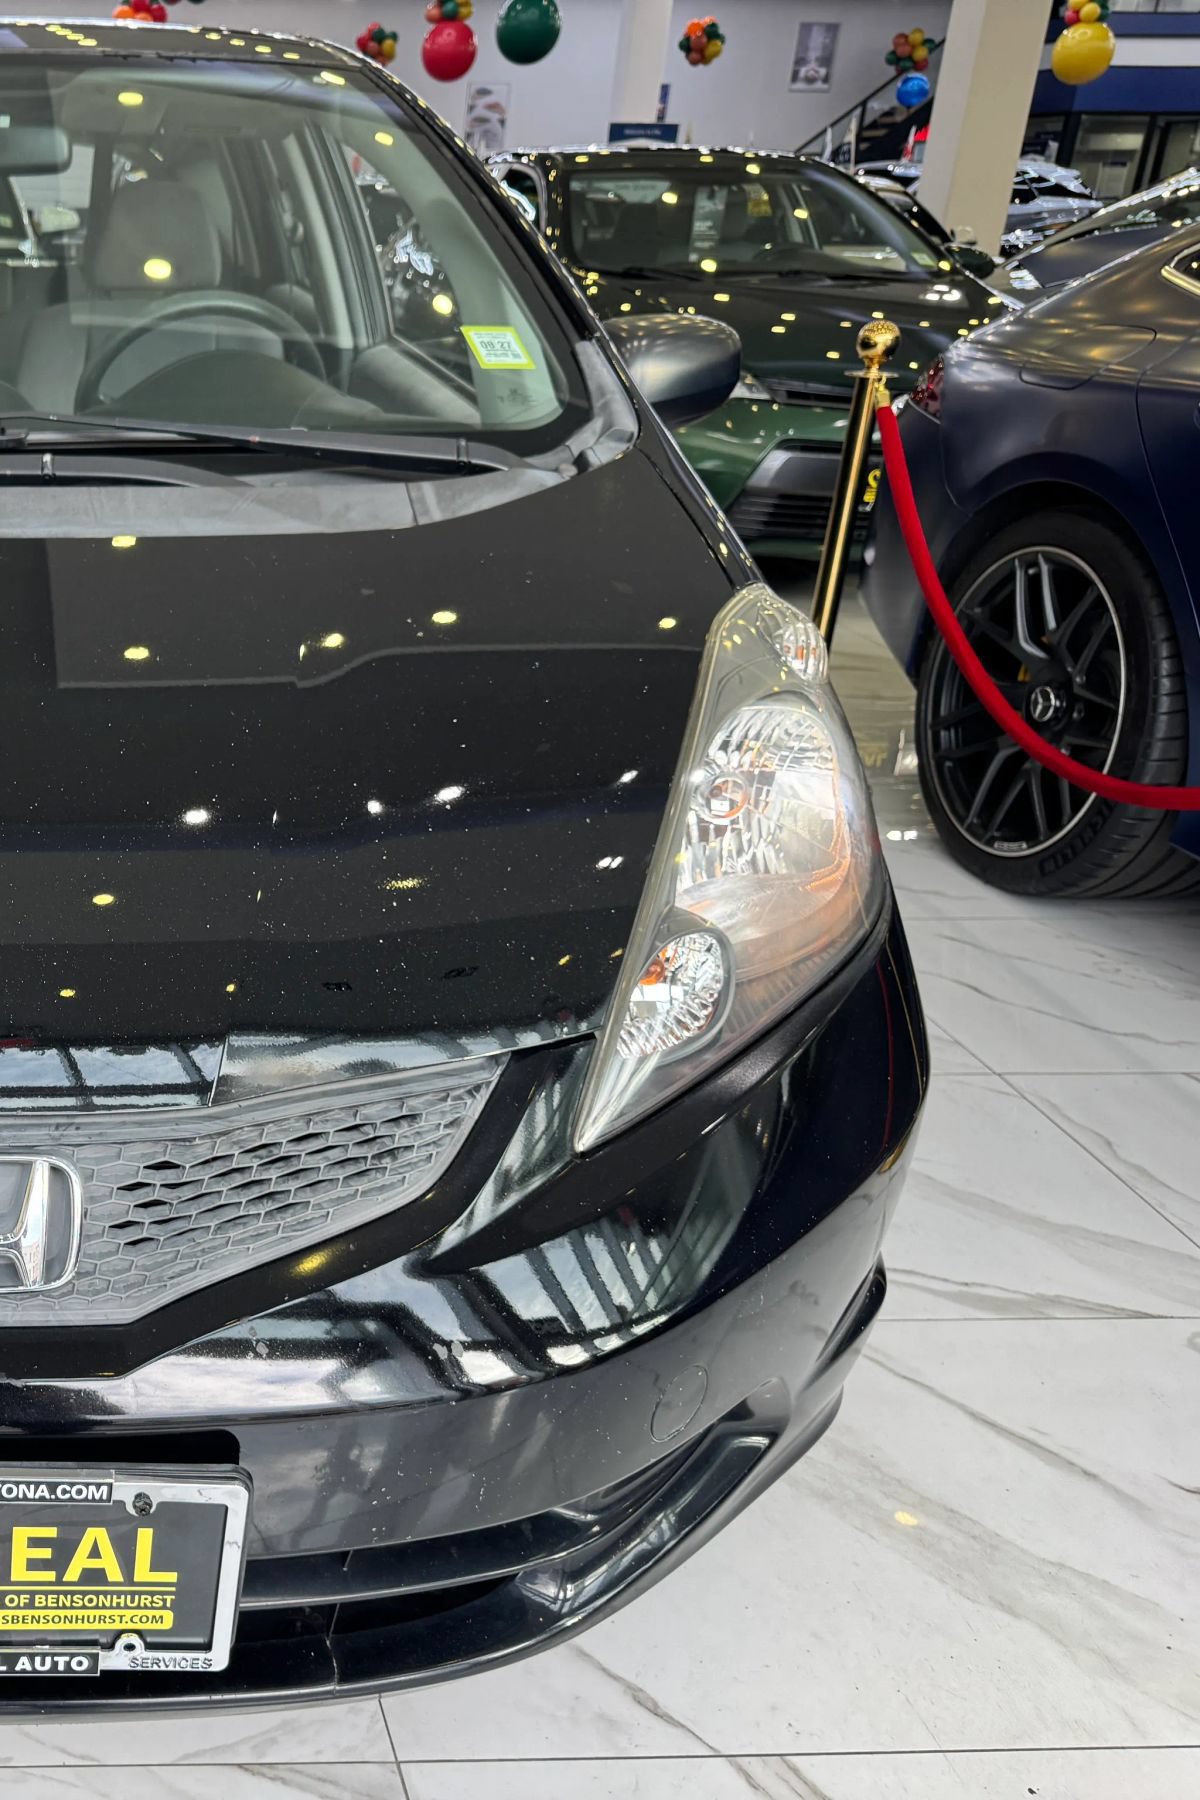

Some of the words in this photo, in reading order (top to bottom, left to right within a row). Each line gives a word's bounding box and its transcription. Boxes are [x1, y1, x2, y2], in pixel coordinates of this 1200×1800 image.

[5, 1594, 30, 1608] OF
[34, 1593, 176, 1608] BENSONHURST
[14, 1655, 89, 1672] AUTO
[127, 1656, 213, 1670] SERVICES
